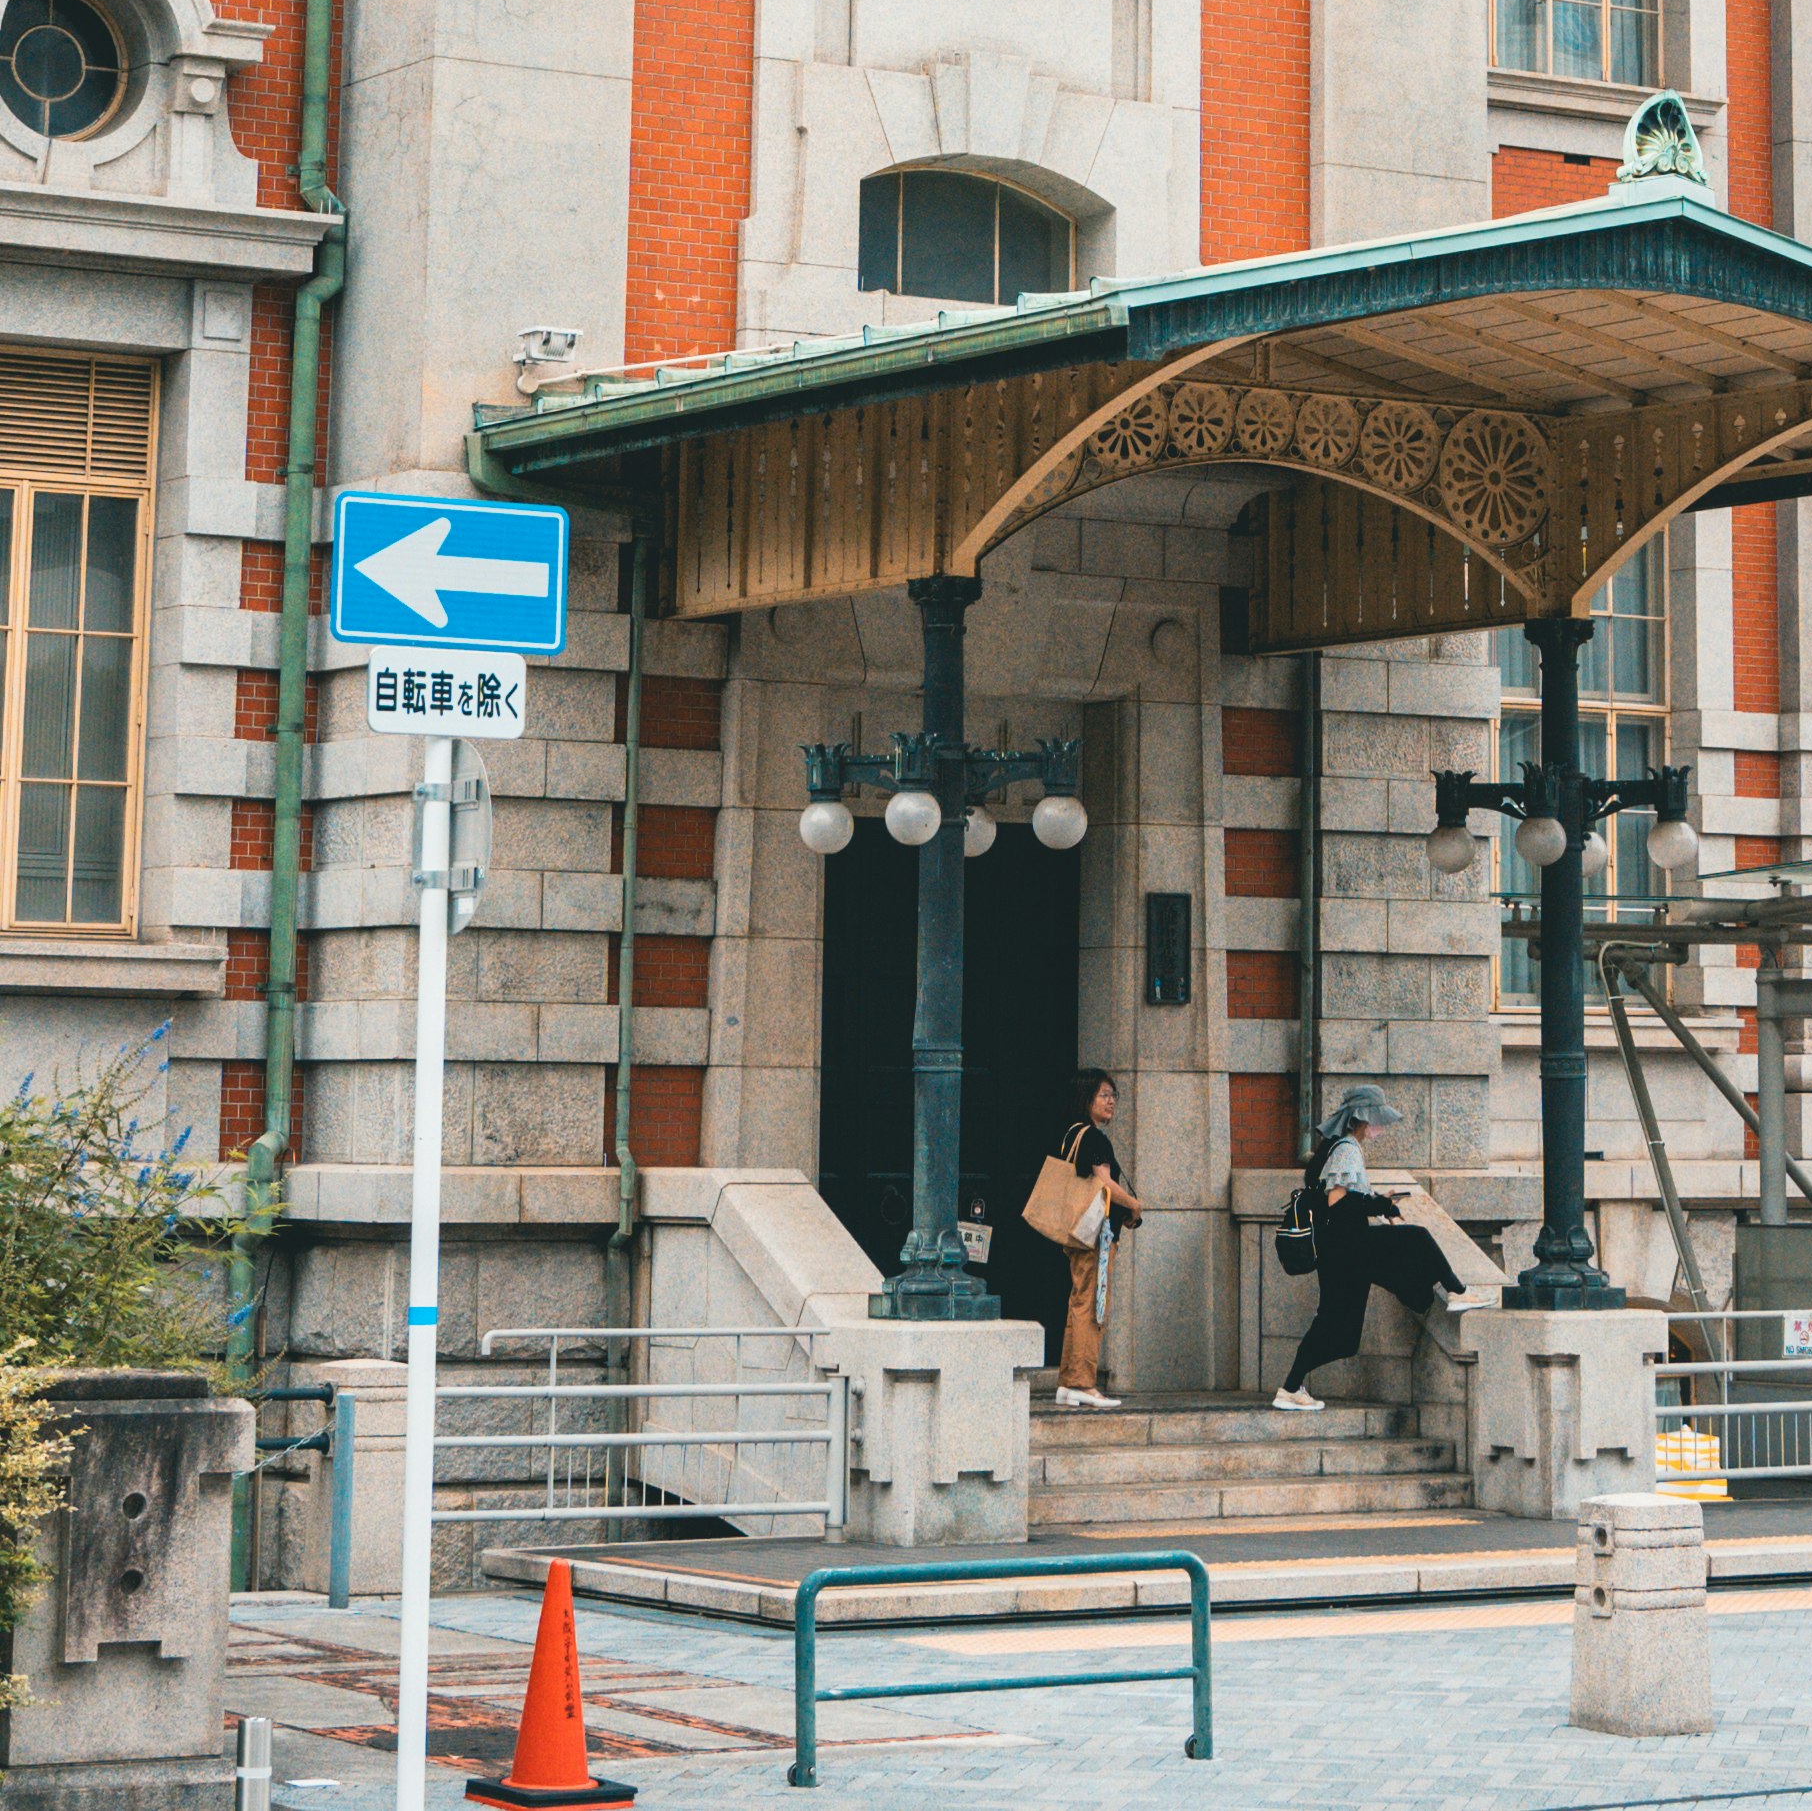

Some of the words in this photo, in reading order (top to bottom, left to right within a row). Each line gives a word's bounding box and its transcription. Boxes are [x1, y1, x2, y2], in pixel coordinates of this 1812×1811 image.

[375, 666, 519, 719] 自転車を除く
[1785, 1345, 1795, 1354] NO
